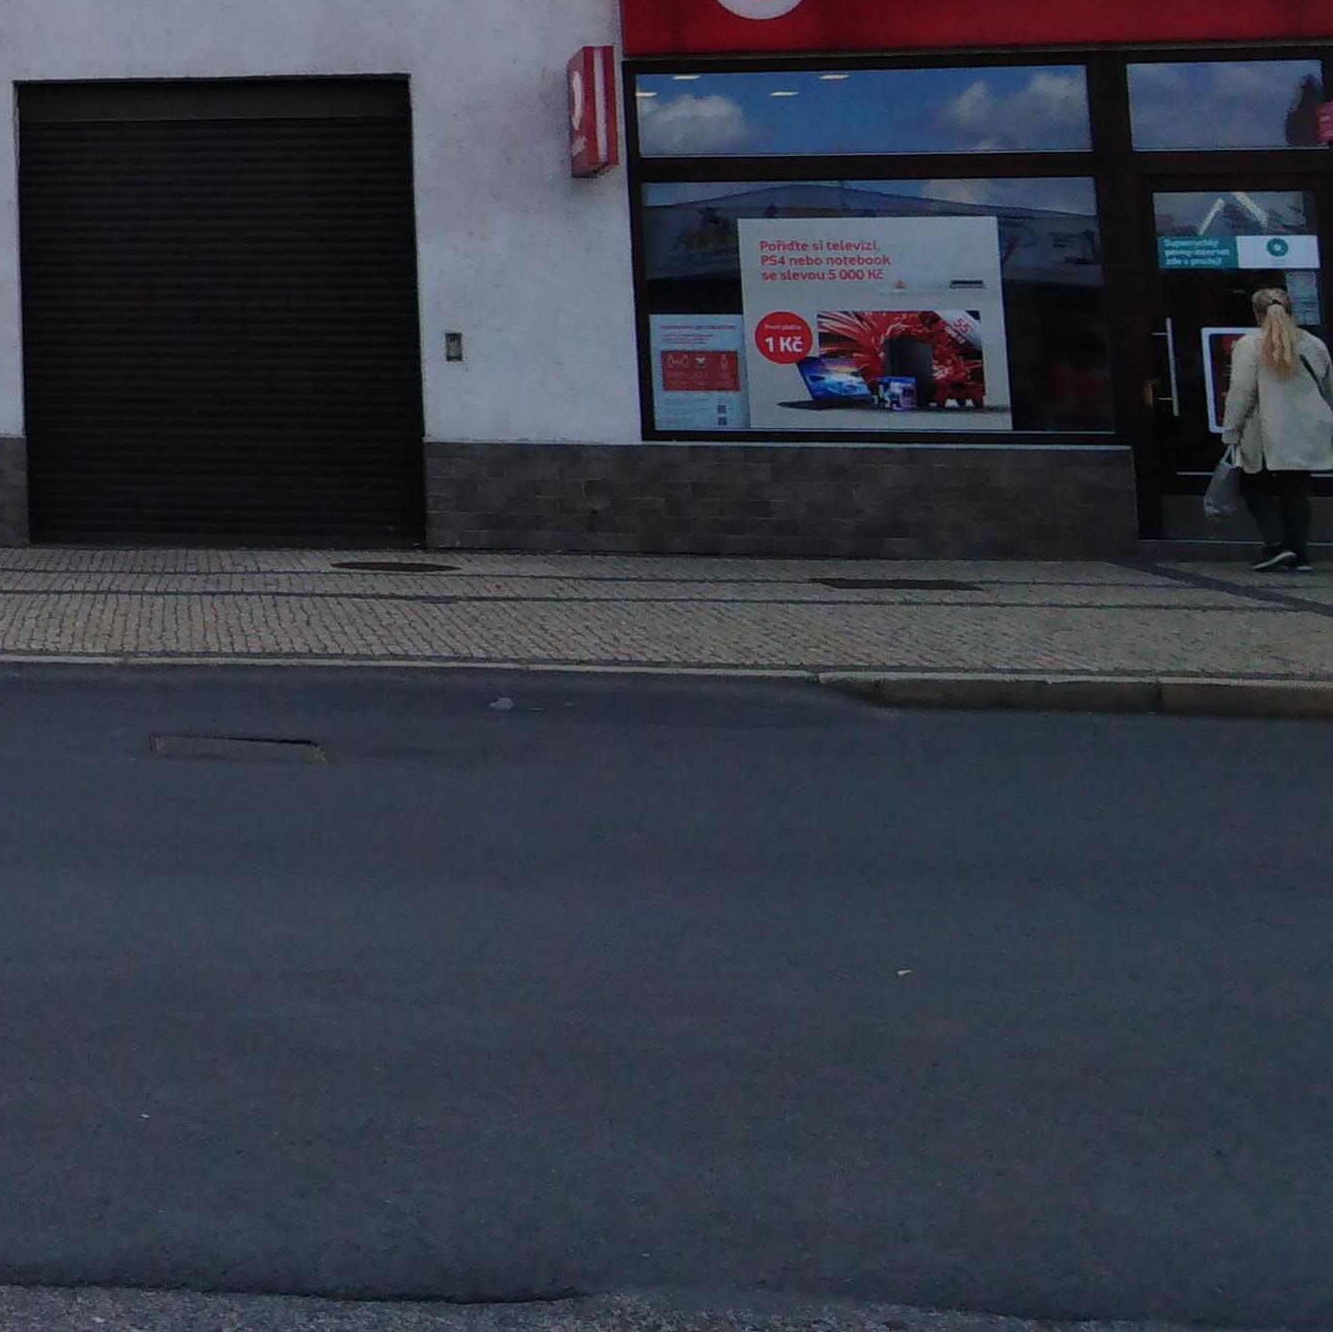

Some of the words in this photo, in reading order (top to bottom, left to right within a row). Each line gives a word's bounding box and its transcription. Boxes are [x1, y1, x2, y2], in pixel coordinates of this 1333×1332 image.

[759, 240, 809, 252] Pořiďte
[812, 240, 823, 251] si
[760, 255, 786, 266] PS4
[789, 254, 823, 266] nebo
[826, 254, 891, 266] notebook
[761, 271, 777, 281] se
[780, 269, 826, 281] slevou
[828, 270, 836, 280] 5
[839, 269, 864, 280] 000
[868, 268, 885, 280] Kč
[764, 336, 774, 353] 1
[779, 335, 803, 353] Kč
